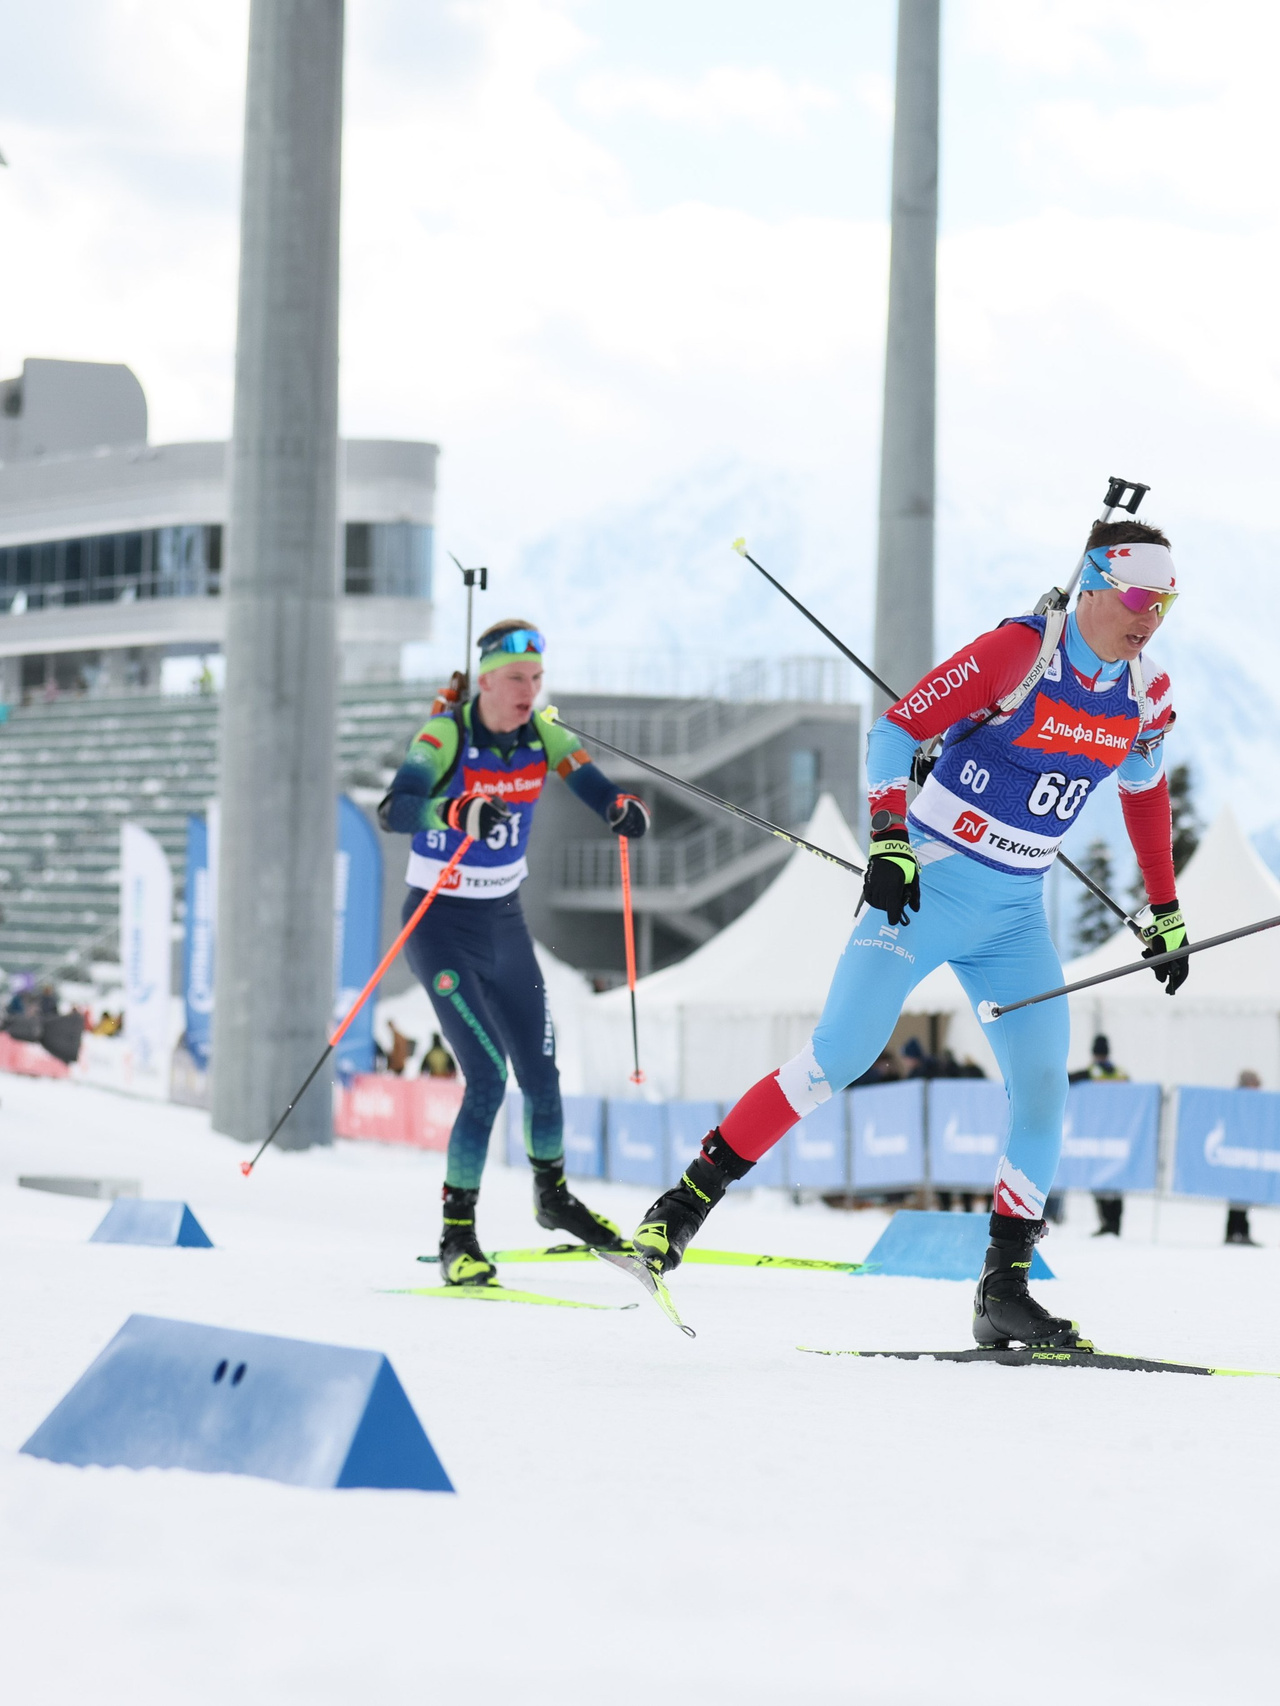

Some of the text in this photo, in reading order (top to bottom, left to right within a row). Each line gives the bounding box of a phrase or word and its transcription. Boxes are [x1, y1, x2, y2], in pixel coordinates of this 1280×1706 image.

[893, 655, 981, 720] МОСКВА
[1022, 656, 1047, 690] LARSEN
[1037, 716, 1130, 750] Альфа Банк
[472, 776, 543, 795] Альфа Банк
[960, 759, 990, 794] 60
[1028, 771, 1092, 821] 60
[426, 829, 447, 852] 51
[485, 812, 522, 850] 51
[853, 938, 916, 965] NORDSKI
[1031, 1351, 1072, 1361] FISCHER
